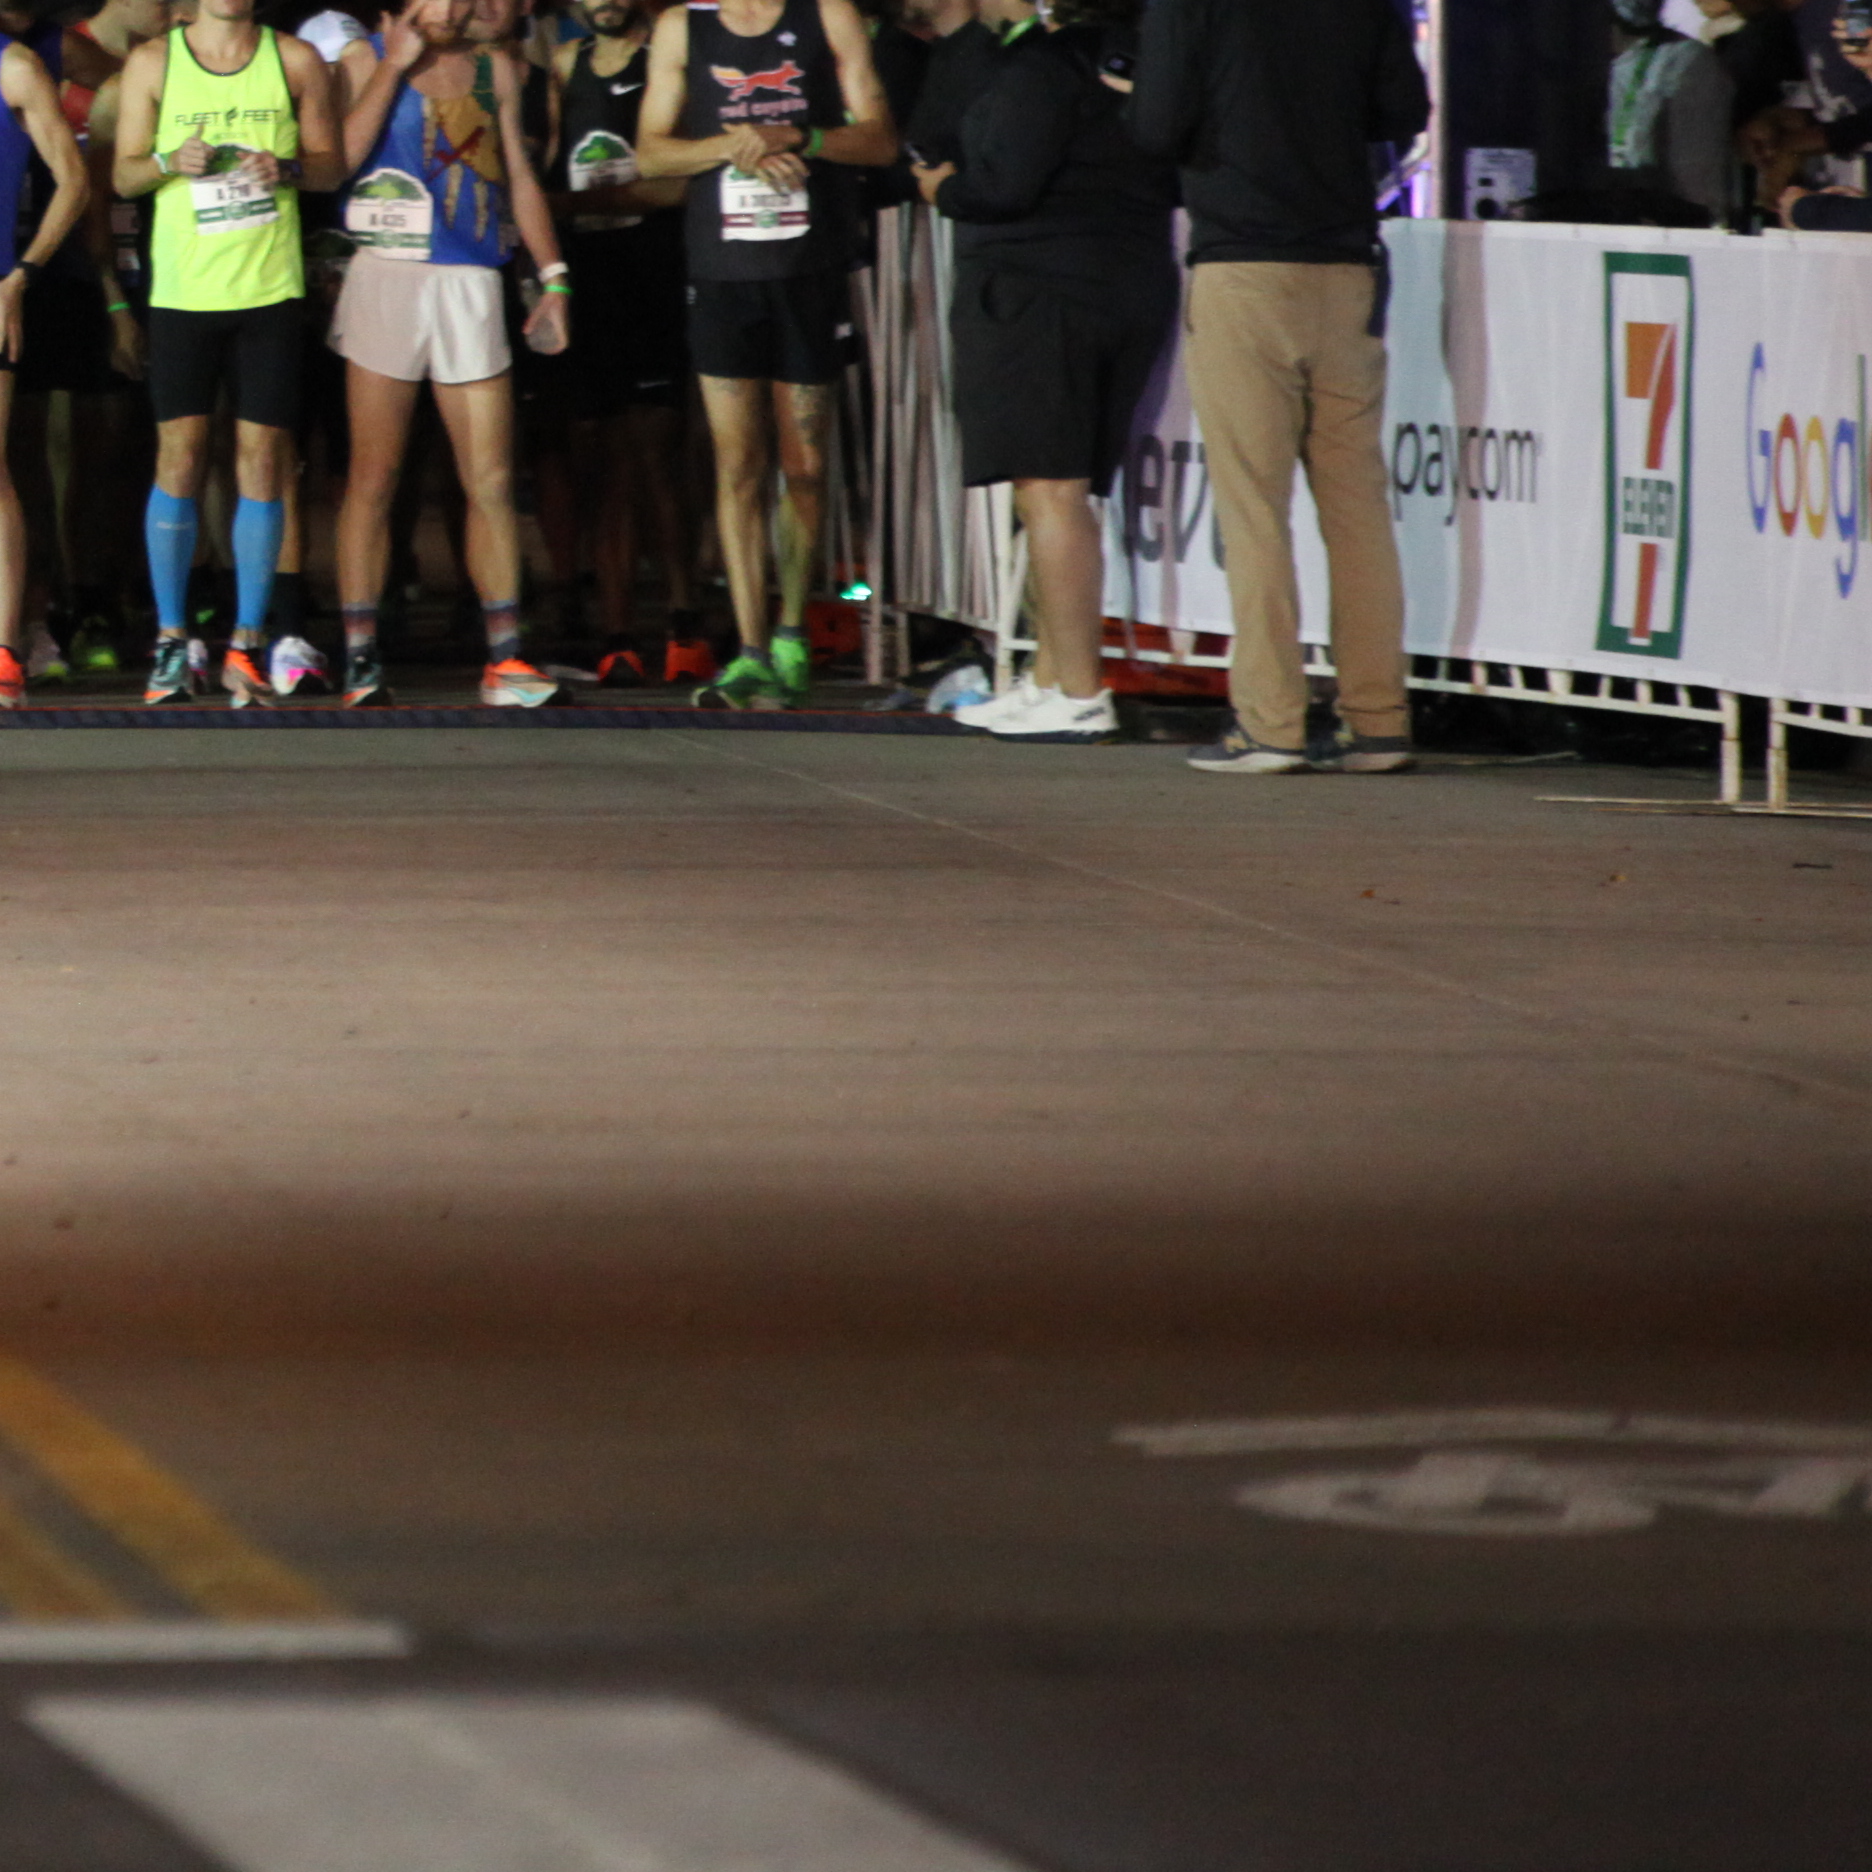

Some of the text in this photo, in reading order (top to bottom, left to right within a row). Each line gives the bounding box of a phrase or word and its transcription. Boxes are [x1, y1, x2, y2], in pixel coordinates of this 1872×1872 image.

[175, 109, 281, 126] FLEET FEET
[1391, 422, 1538, 526] paycom
[1747, 340, 1872, 599] Googl
